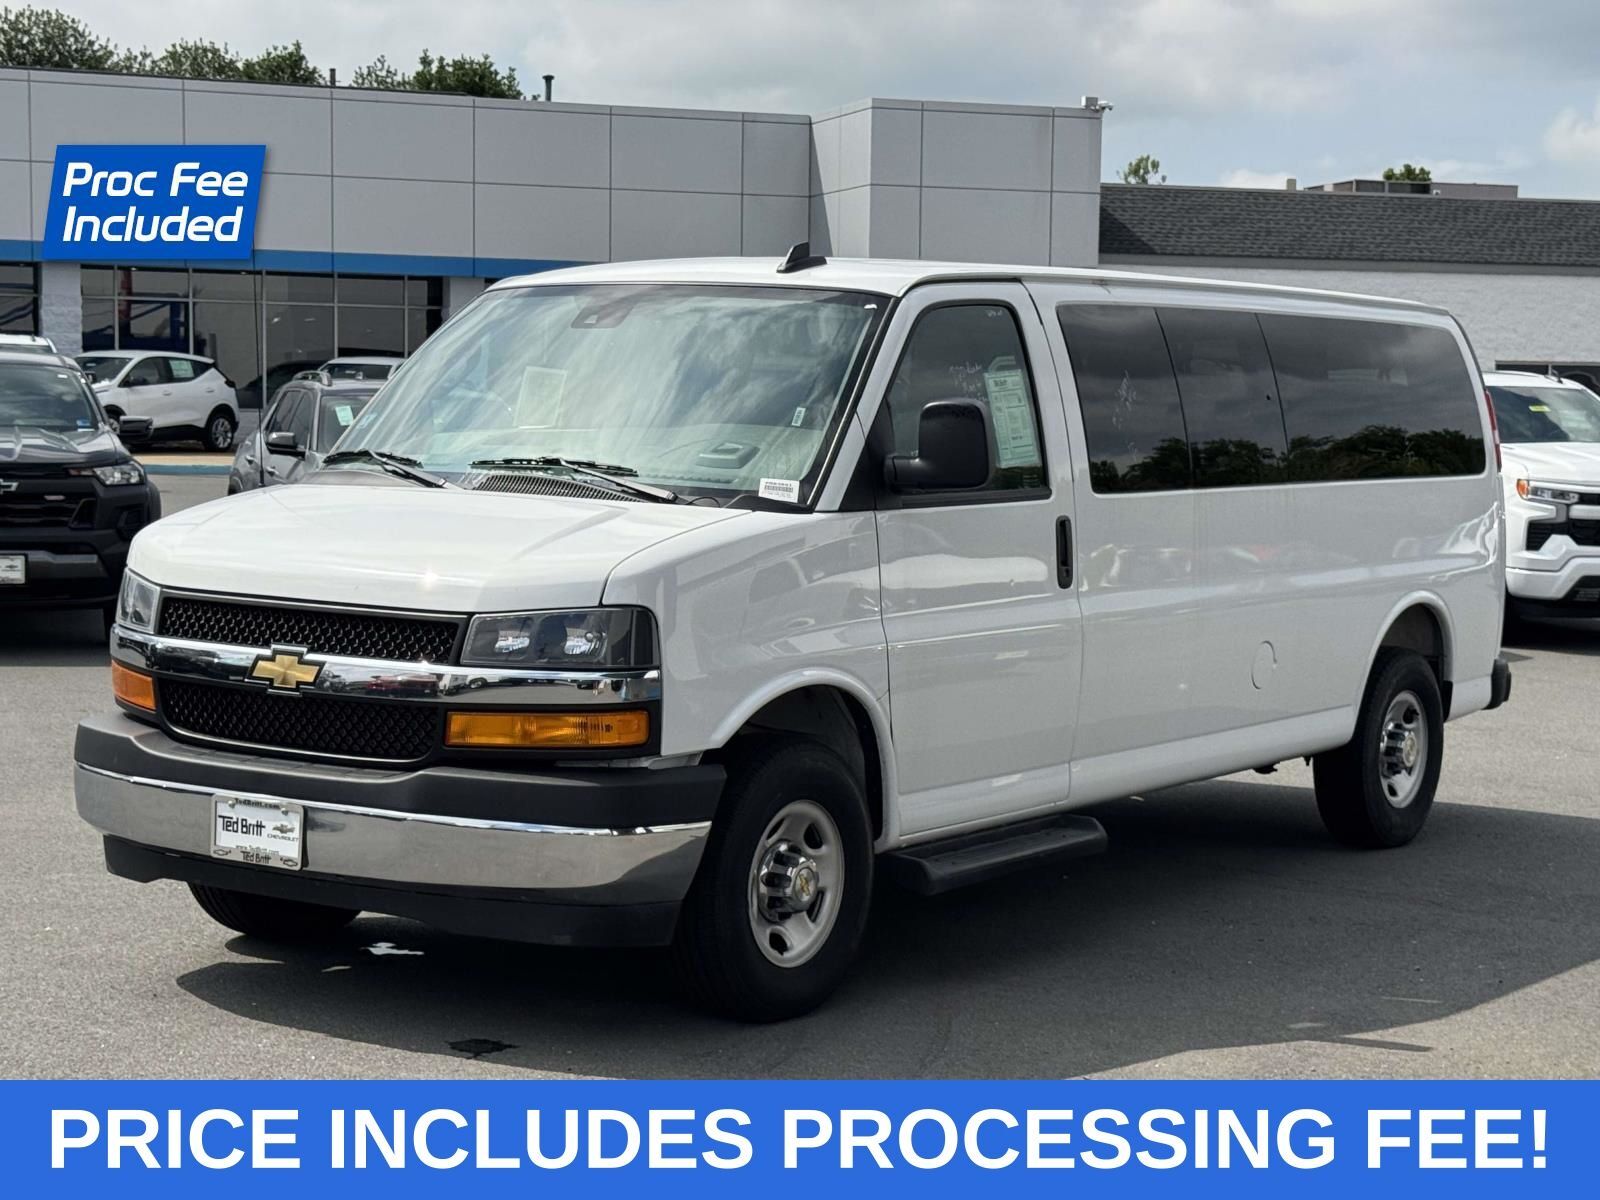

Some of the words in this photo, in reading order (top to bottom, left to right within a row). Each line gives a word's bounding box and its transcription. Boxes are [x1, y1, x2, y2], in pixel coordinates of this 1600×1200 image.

[218, 815, 239, 833] Ted
[241, 818, 266, 837] Britt
[267, 833, 299, 842] CHEVROLET
[240, 851, 255, 862] Ted
[255, 852, 272, 864] Britt
